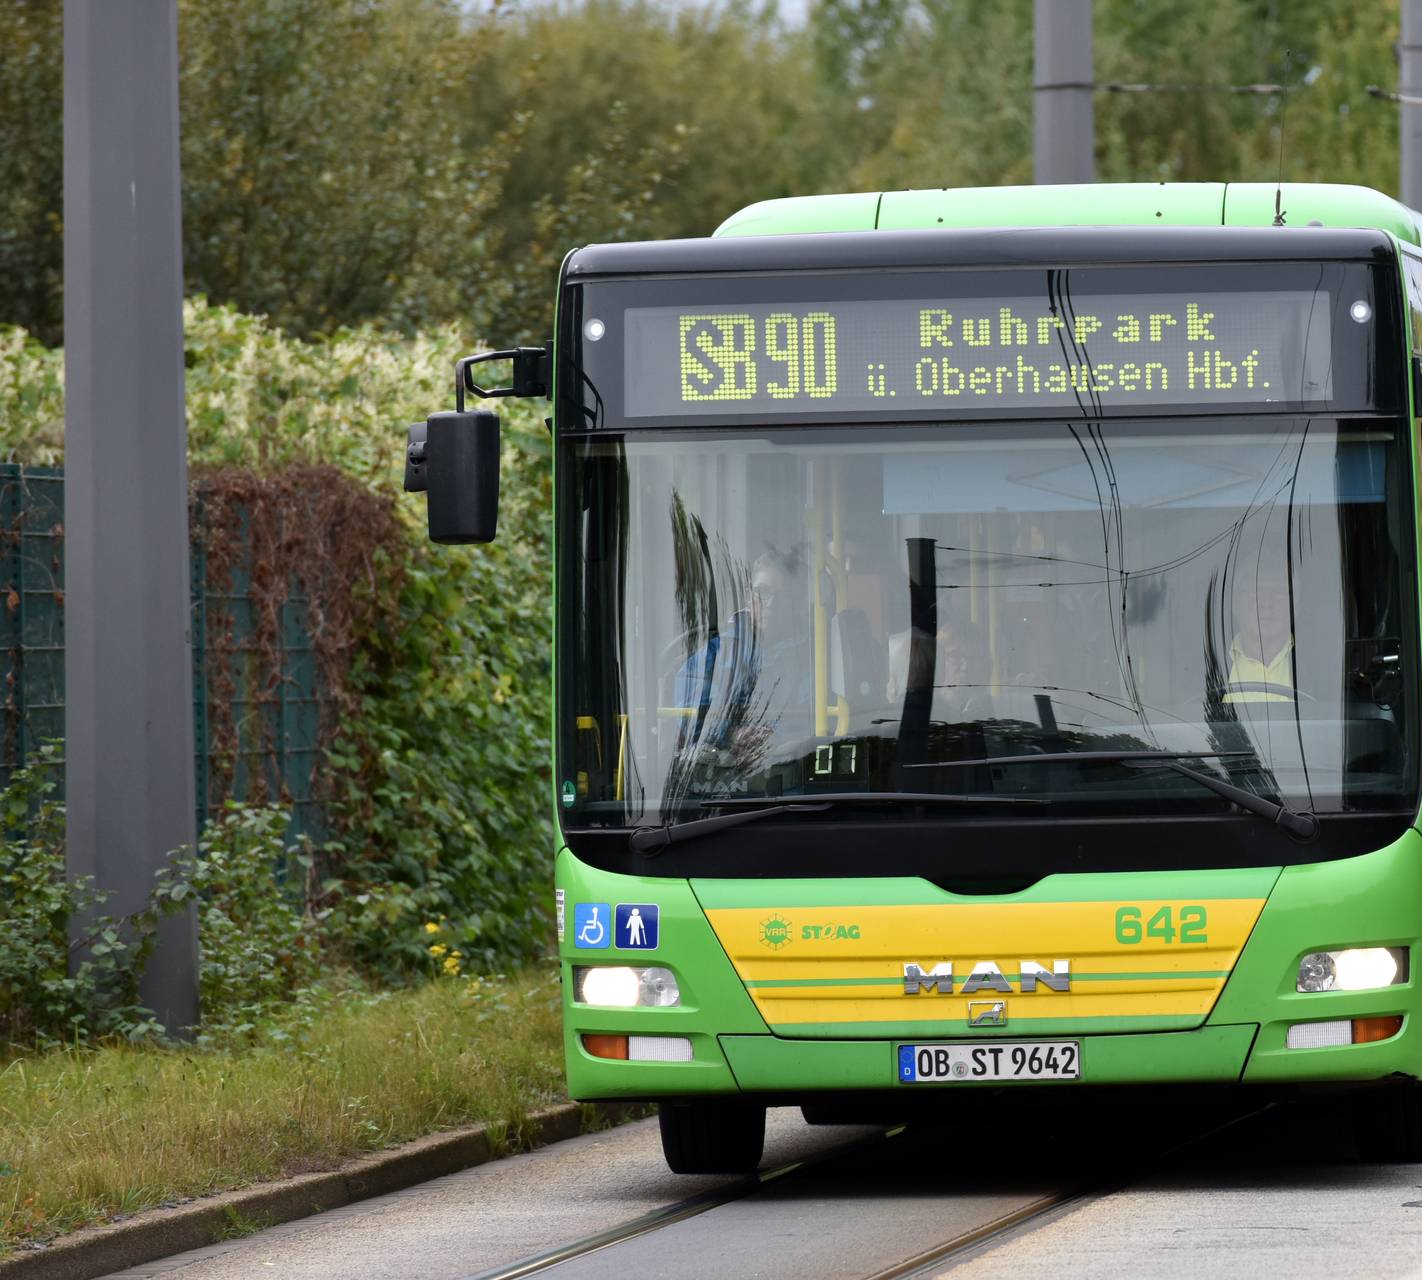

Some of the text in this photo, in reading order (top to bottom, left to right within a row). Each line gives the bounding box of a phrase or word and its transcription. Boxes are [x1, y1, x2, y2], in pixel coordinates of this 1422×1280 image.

[919, 303, 1215, 347] Ruhrpark
[867, 350, 1271, 396] ü. Oberhausen Hbf.
[815, 744, 856, 774] 07
[765, 928, 787, 937] VRR
[801, 922, 861, 940] STOAG
[1115, 905, 1209, 944] 642
[903, 960, 1071, 994] MAN
[904, 1067, 911, 1076] D
[917, 1046, 1077, 1077] OB ST 9642
